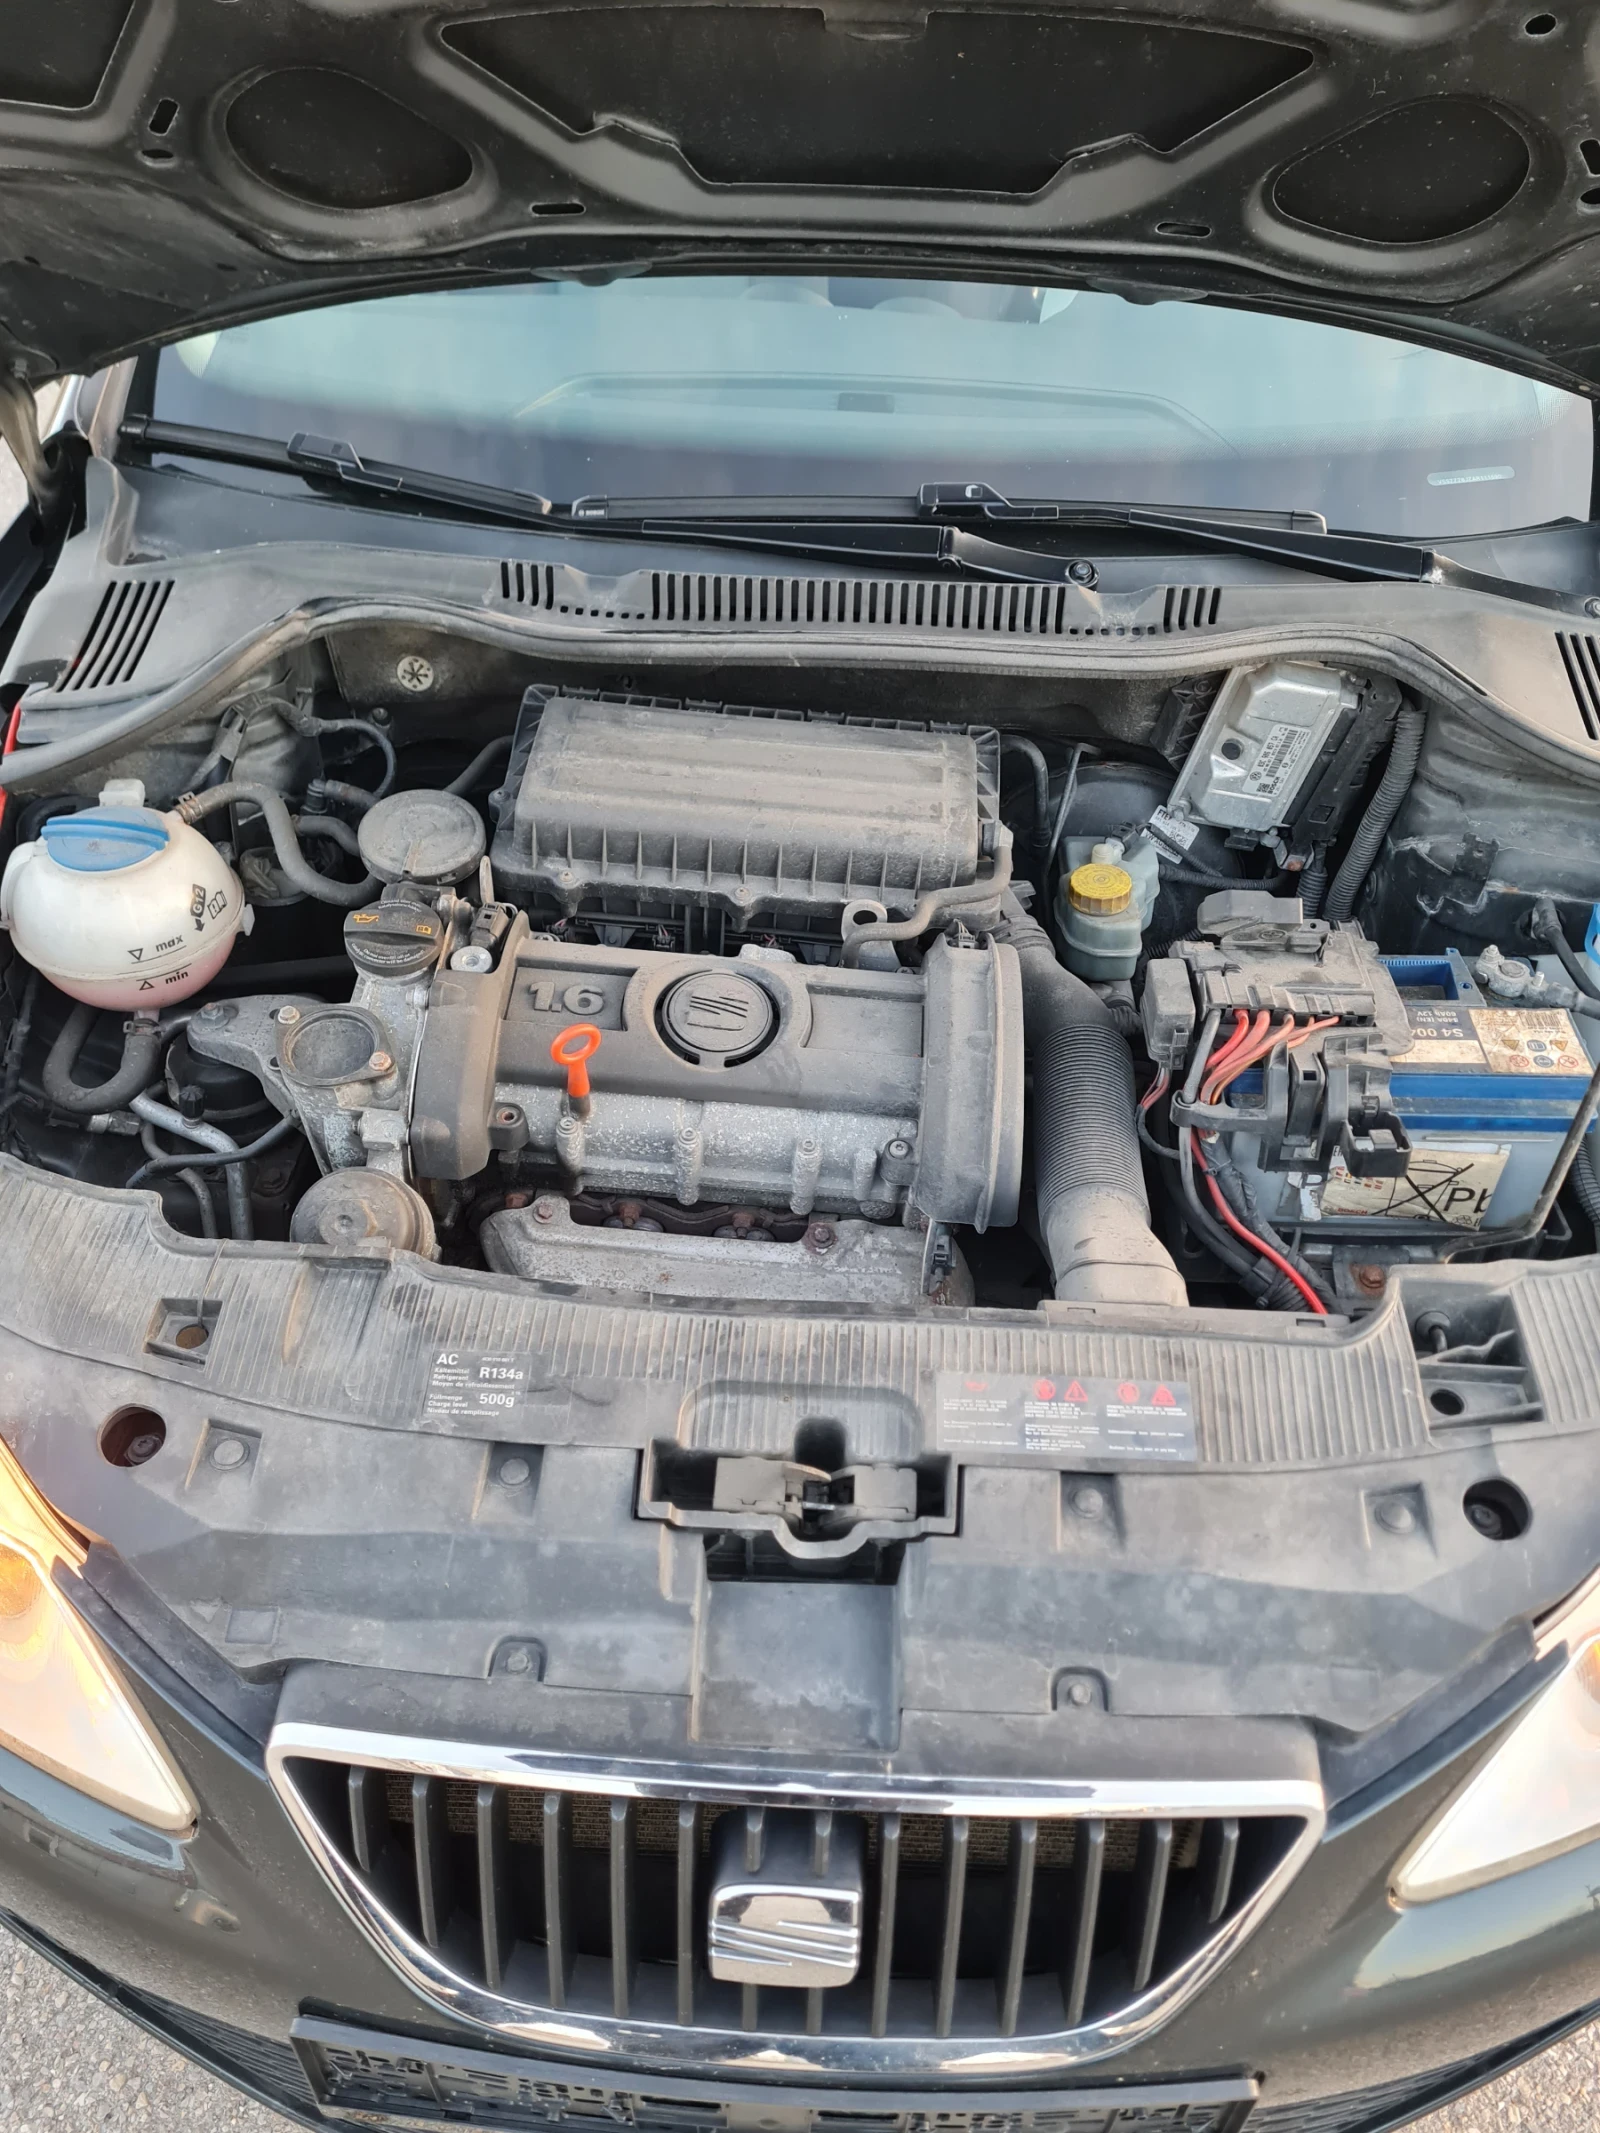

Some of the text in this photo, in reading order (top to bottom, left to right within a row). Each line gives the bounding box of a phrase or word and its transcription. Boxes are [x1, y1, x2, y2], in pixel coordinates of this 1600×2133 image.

[193, 888, 205, 914] G12
[155, 934, 184, 952] max
[165, 971, 189, 984] min
[528, 981, 604, 1015] 1.6
[1442, 1028, 1464, 1038] S4
[436, 1353, 459, 1365] AC
[433, 1373, 469, 1381] Refrigerant
[479, 1366, 524, 1380] R134a
[432, 1380, 454, 1388] Moyen
[428, 1400, 451, 1408] Charge
[479, 1393, 515, 1408] 500g
